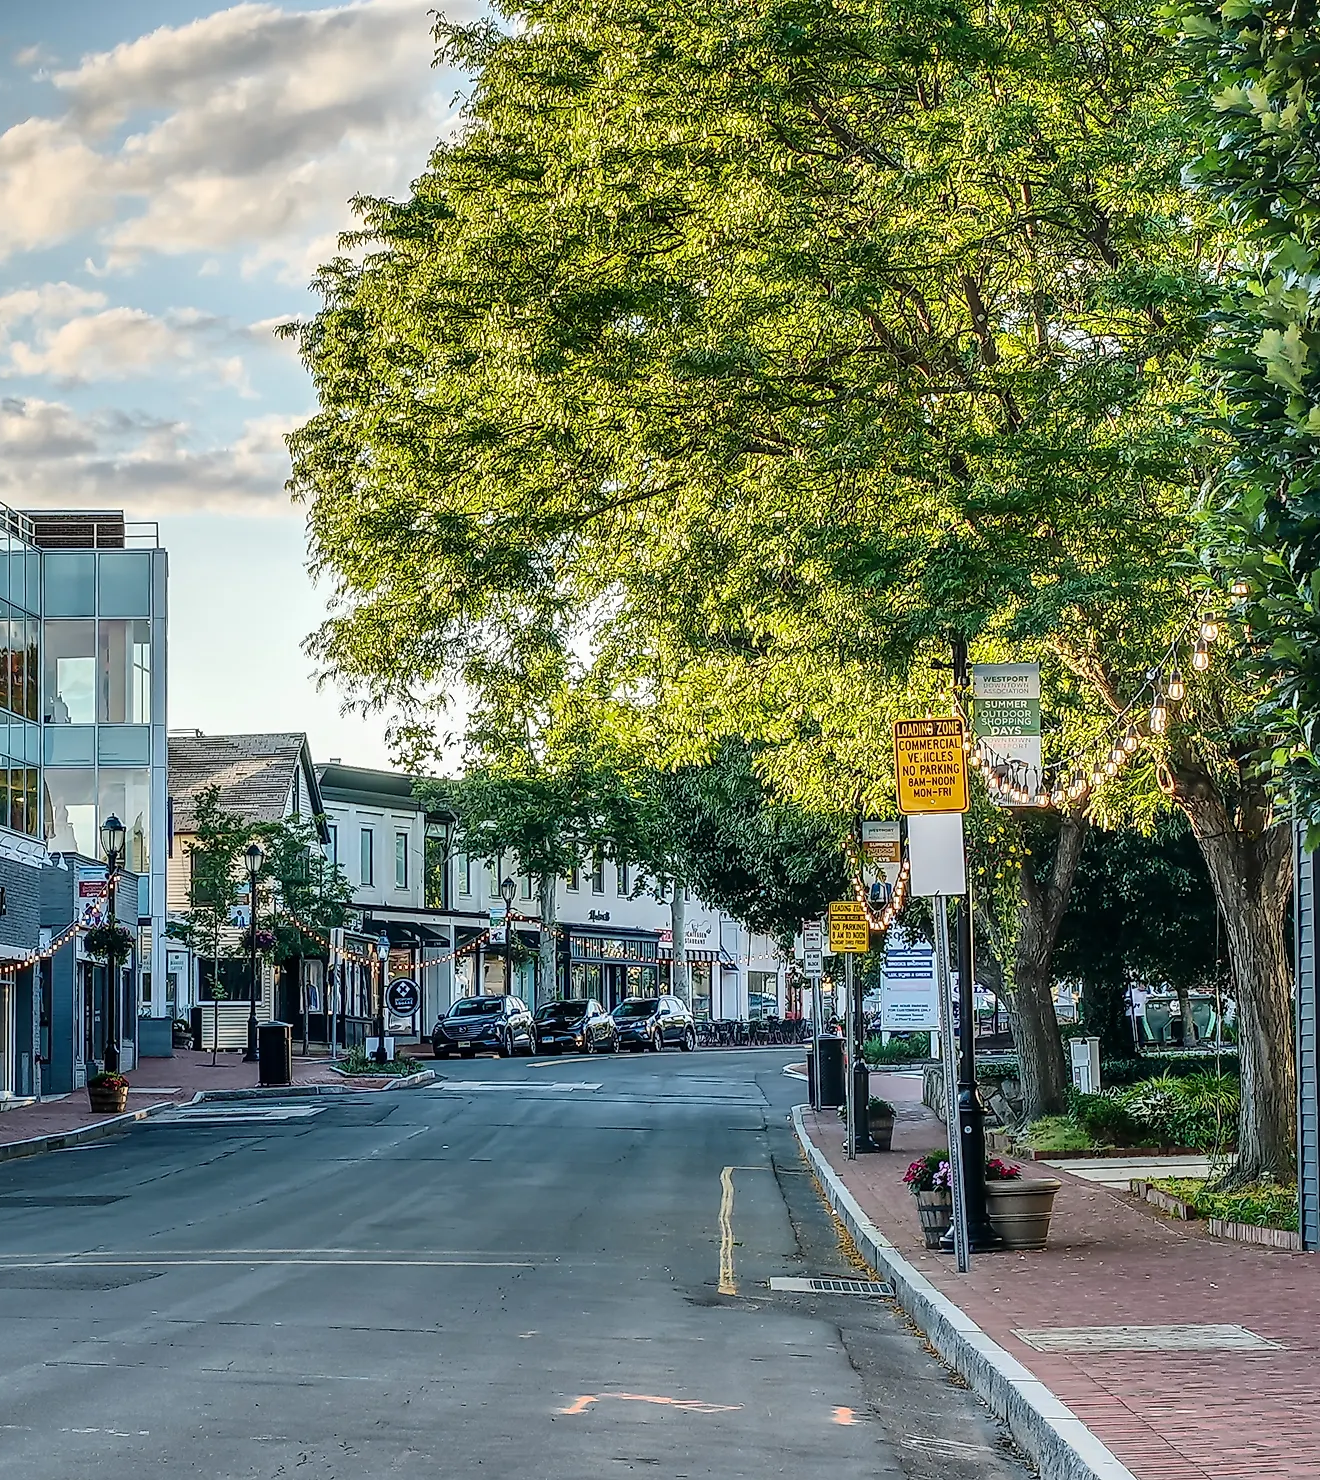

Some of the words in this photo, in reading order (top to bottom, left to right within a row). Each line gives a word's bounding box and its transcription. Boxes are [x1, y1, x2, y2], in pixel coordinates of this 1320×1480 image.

[985, 700, 1027, 708] SUMMER
[981, 710, 1031, 718] OUTDOOR
[981, 718, 1031, 726] SHOPPING
[897, 722, 933, 737] LOADING
[936, 721, 961, 735] ZONE
[991, 726, 1022, 735] DAYS
[899, 738, 960, 751] COMMERCIAL
[908, 751, 953, 763] VEHICLES
[902, 765, 916, 776] NO
[920, 763, 959, 775] PARKING
[908, 776, 955, 787] 8AM-NOON
[913, 787, 952, 798] MON-FRI
